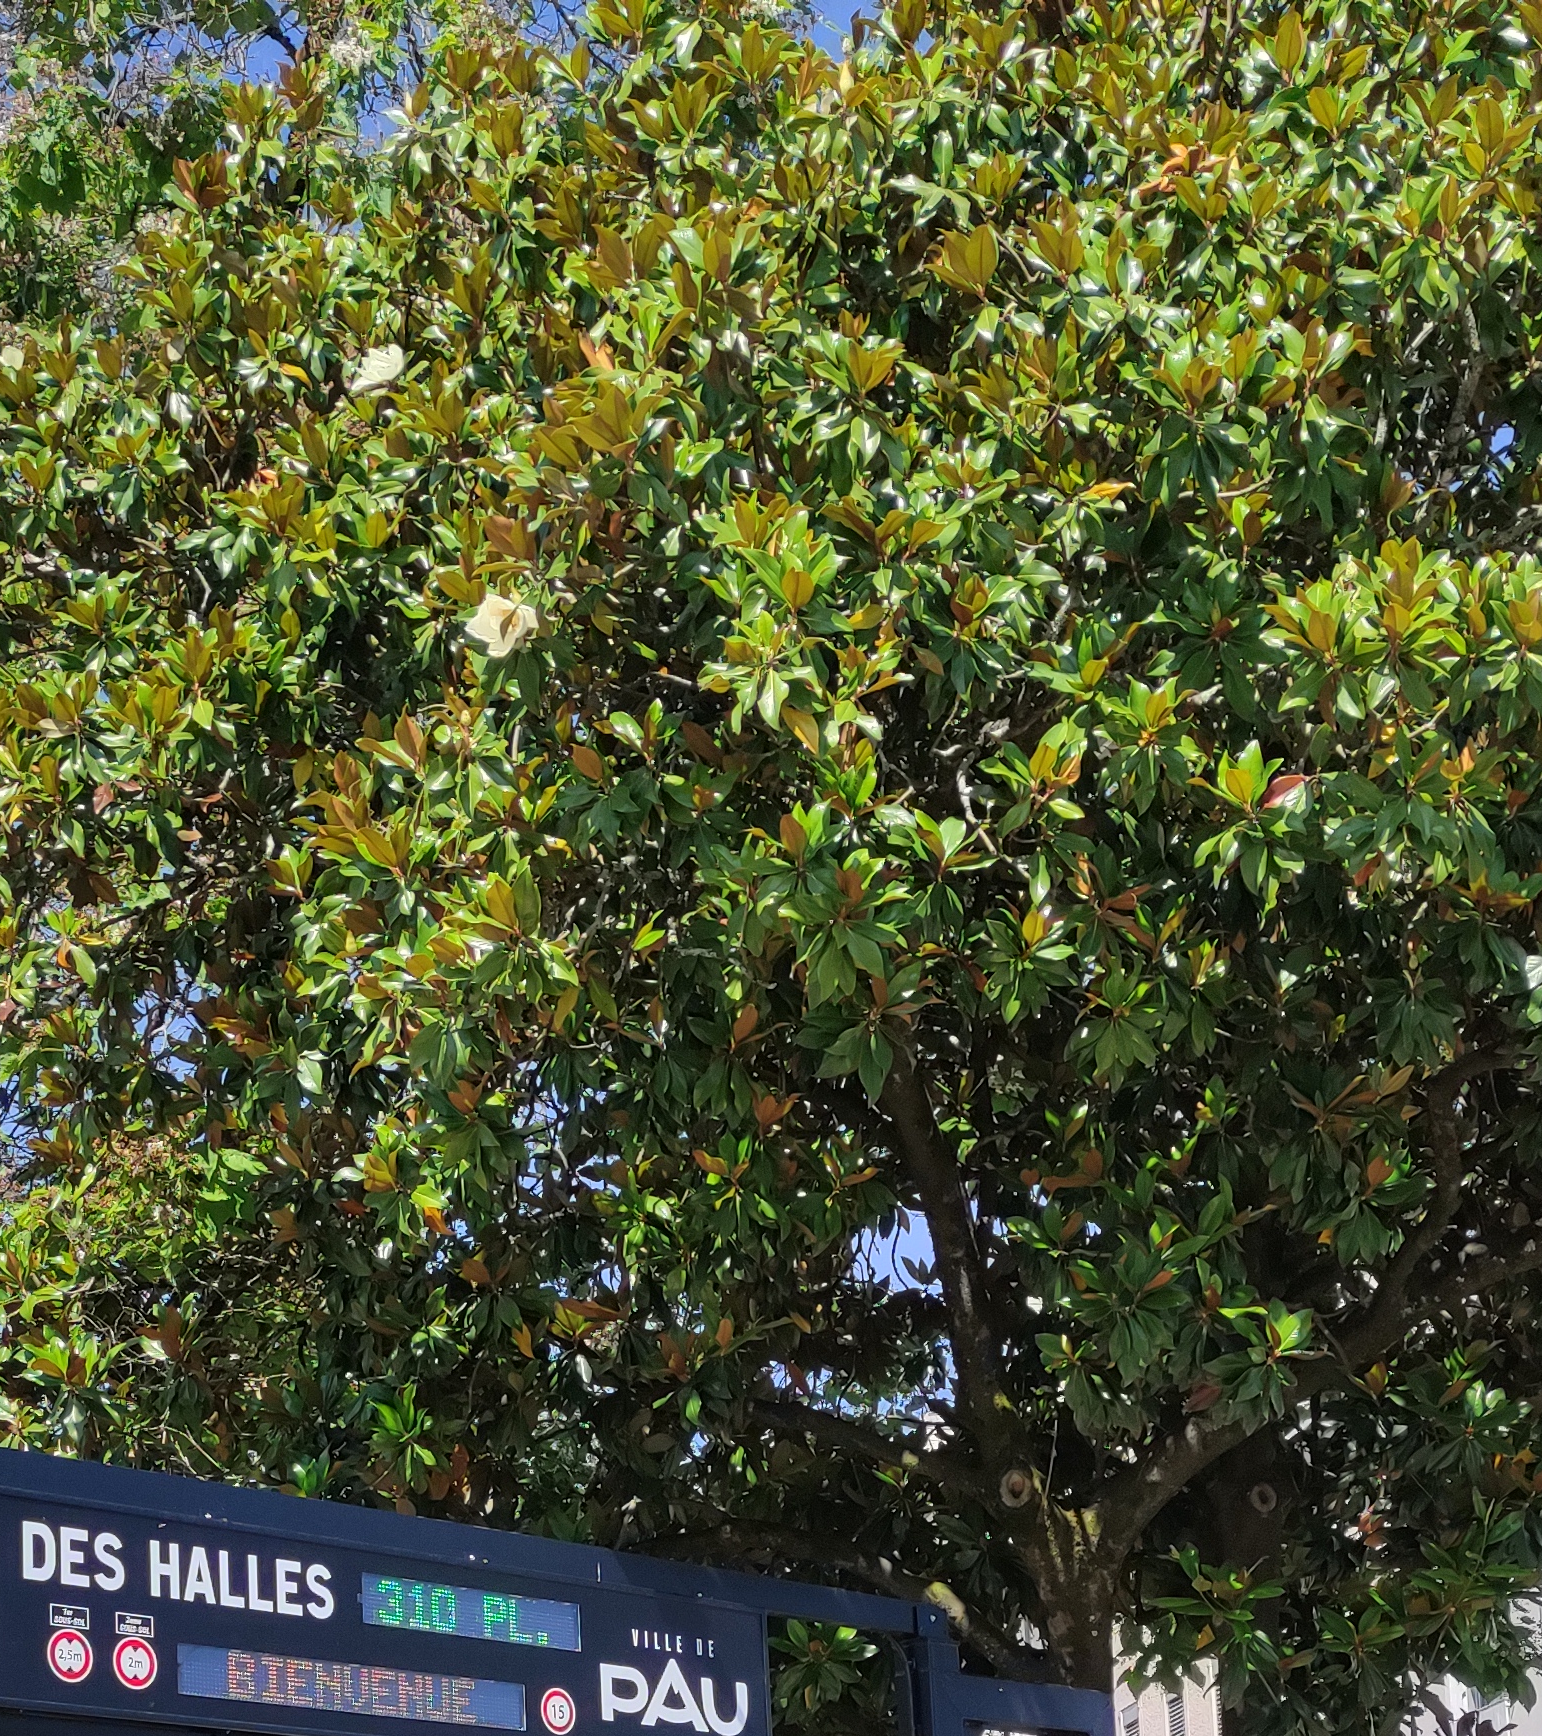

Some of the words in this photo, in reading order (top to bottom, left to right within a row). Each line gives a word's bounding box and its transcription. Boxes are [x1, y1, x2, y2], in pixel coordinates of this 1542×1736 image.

[22, 1520, 125, 1592] DES
[150, 1539, 336, 1620] HALLES
[377, 1579, 457, 1632] 310
[58, 1649, 82, 1662] 2,5m
[128, 1657, 144, 1669] 2m
[632, 1628, 683, 1653] VILLE
[696, 1637, 716, 1658] DE
[226, 1650, 478, 1724] BIENVENUE
[599, 1658, 748, 1736] PAU
[551, 1703, 565, 1720] 15
